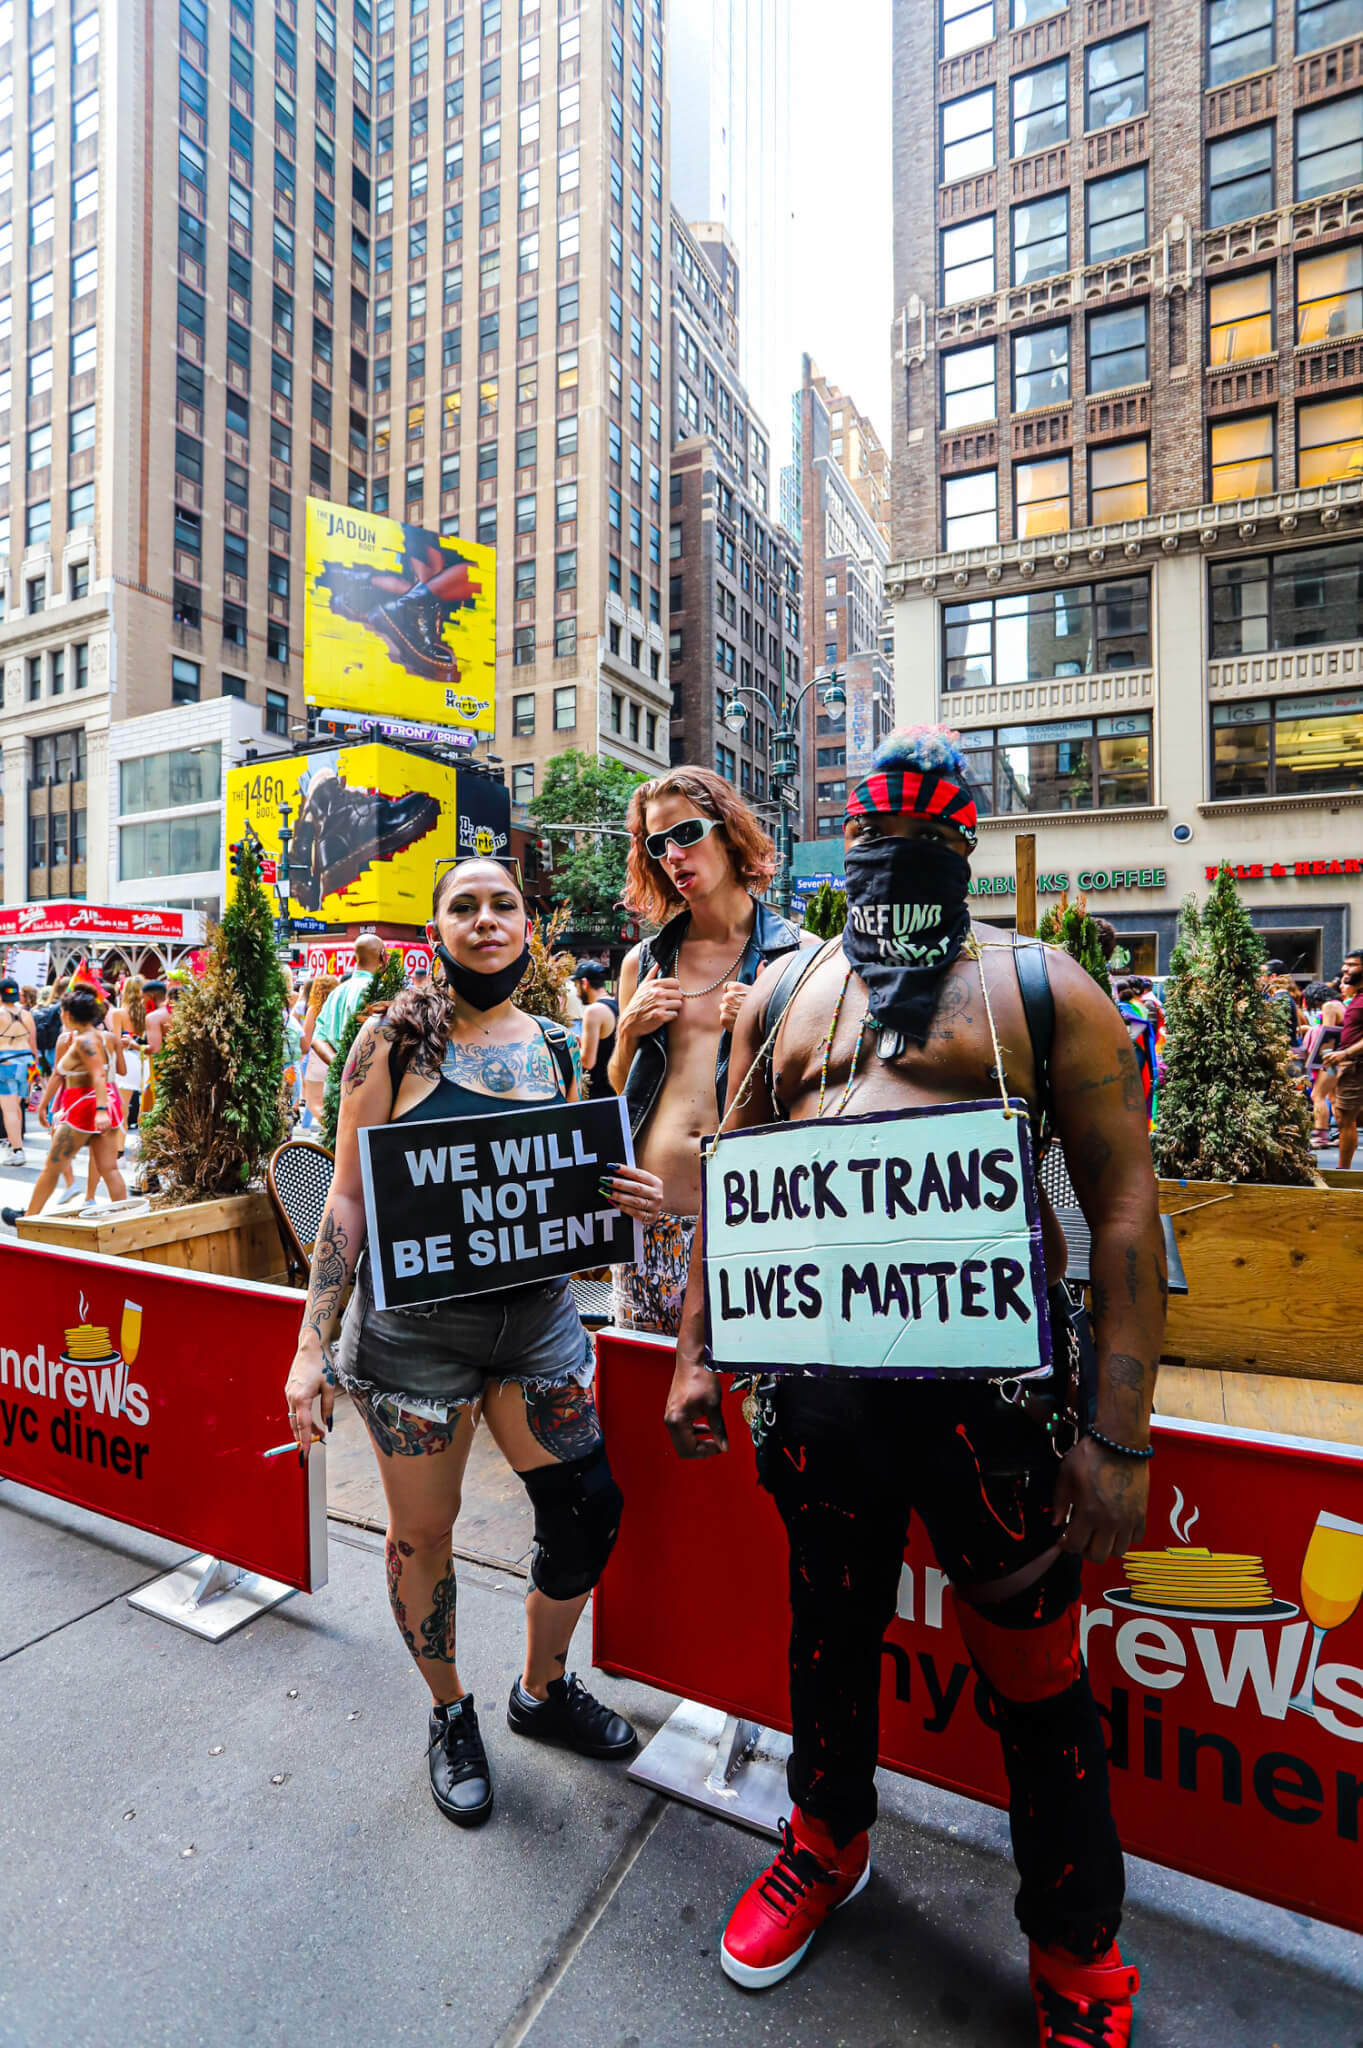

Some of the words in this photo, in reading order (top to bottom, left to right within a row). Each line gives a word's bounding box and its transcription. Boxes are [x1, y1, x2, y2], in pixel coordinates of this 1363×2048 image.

[326, 513, 376, 544] JADUN
[243, 774, 284, 811] 1460
[460, 830, 508, 850] Martens
[1077, 867, 1167, 891] COFFEE
[1270, 862, 1287, 877] &
[1294, 858, 1363, 876] HEAR
[851, 903, 942, 936] DEFUND
[404, 1144, 478, 1187] WE
[490, 1130, 597, 1176] WILL
[461, 1178, 554, 1224] NOT
[723, 1160, 848, 1227] BLACK
[847, 1148, 1019, 1219] TRANS
[392, 1234, 454, 1279] BE
[468, 1208, 621, 1266] SILENT
[719, 1264, 823, 1321] LIVES
[841, 1257, 1032, 1324] MATTER
[51, 1408, 149, 1480] diner
